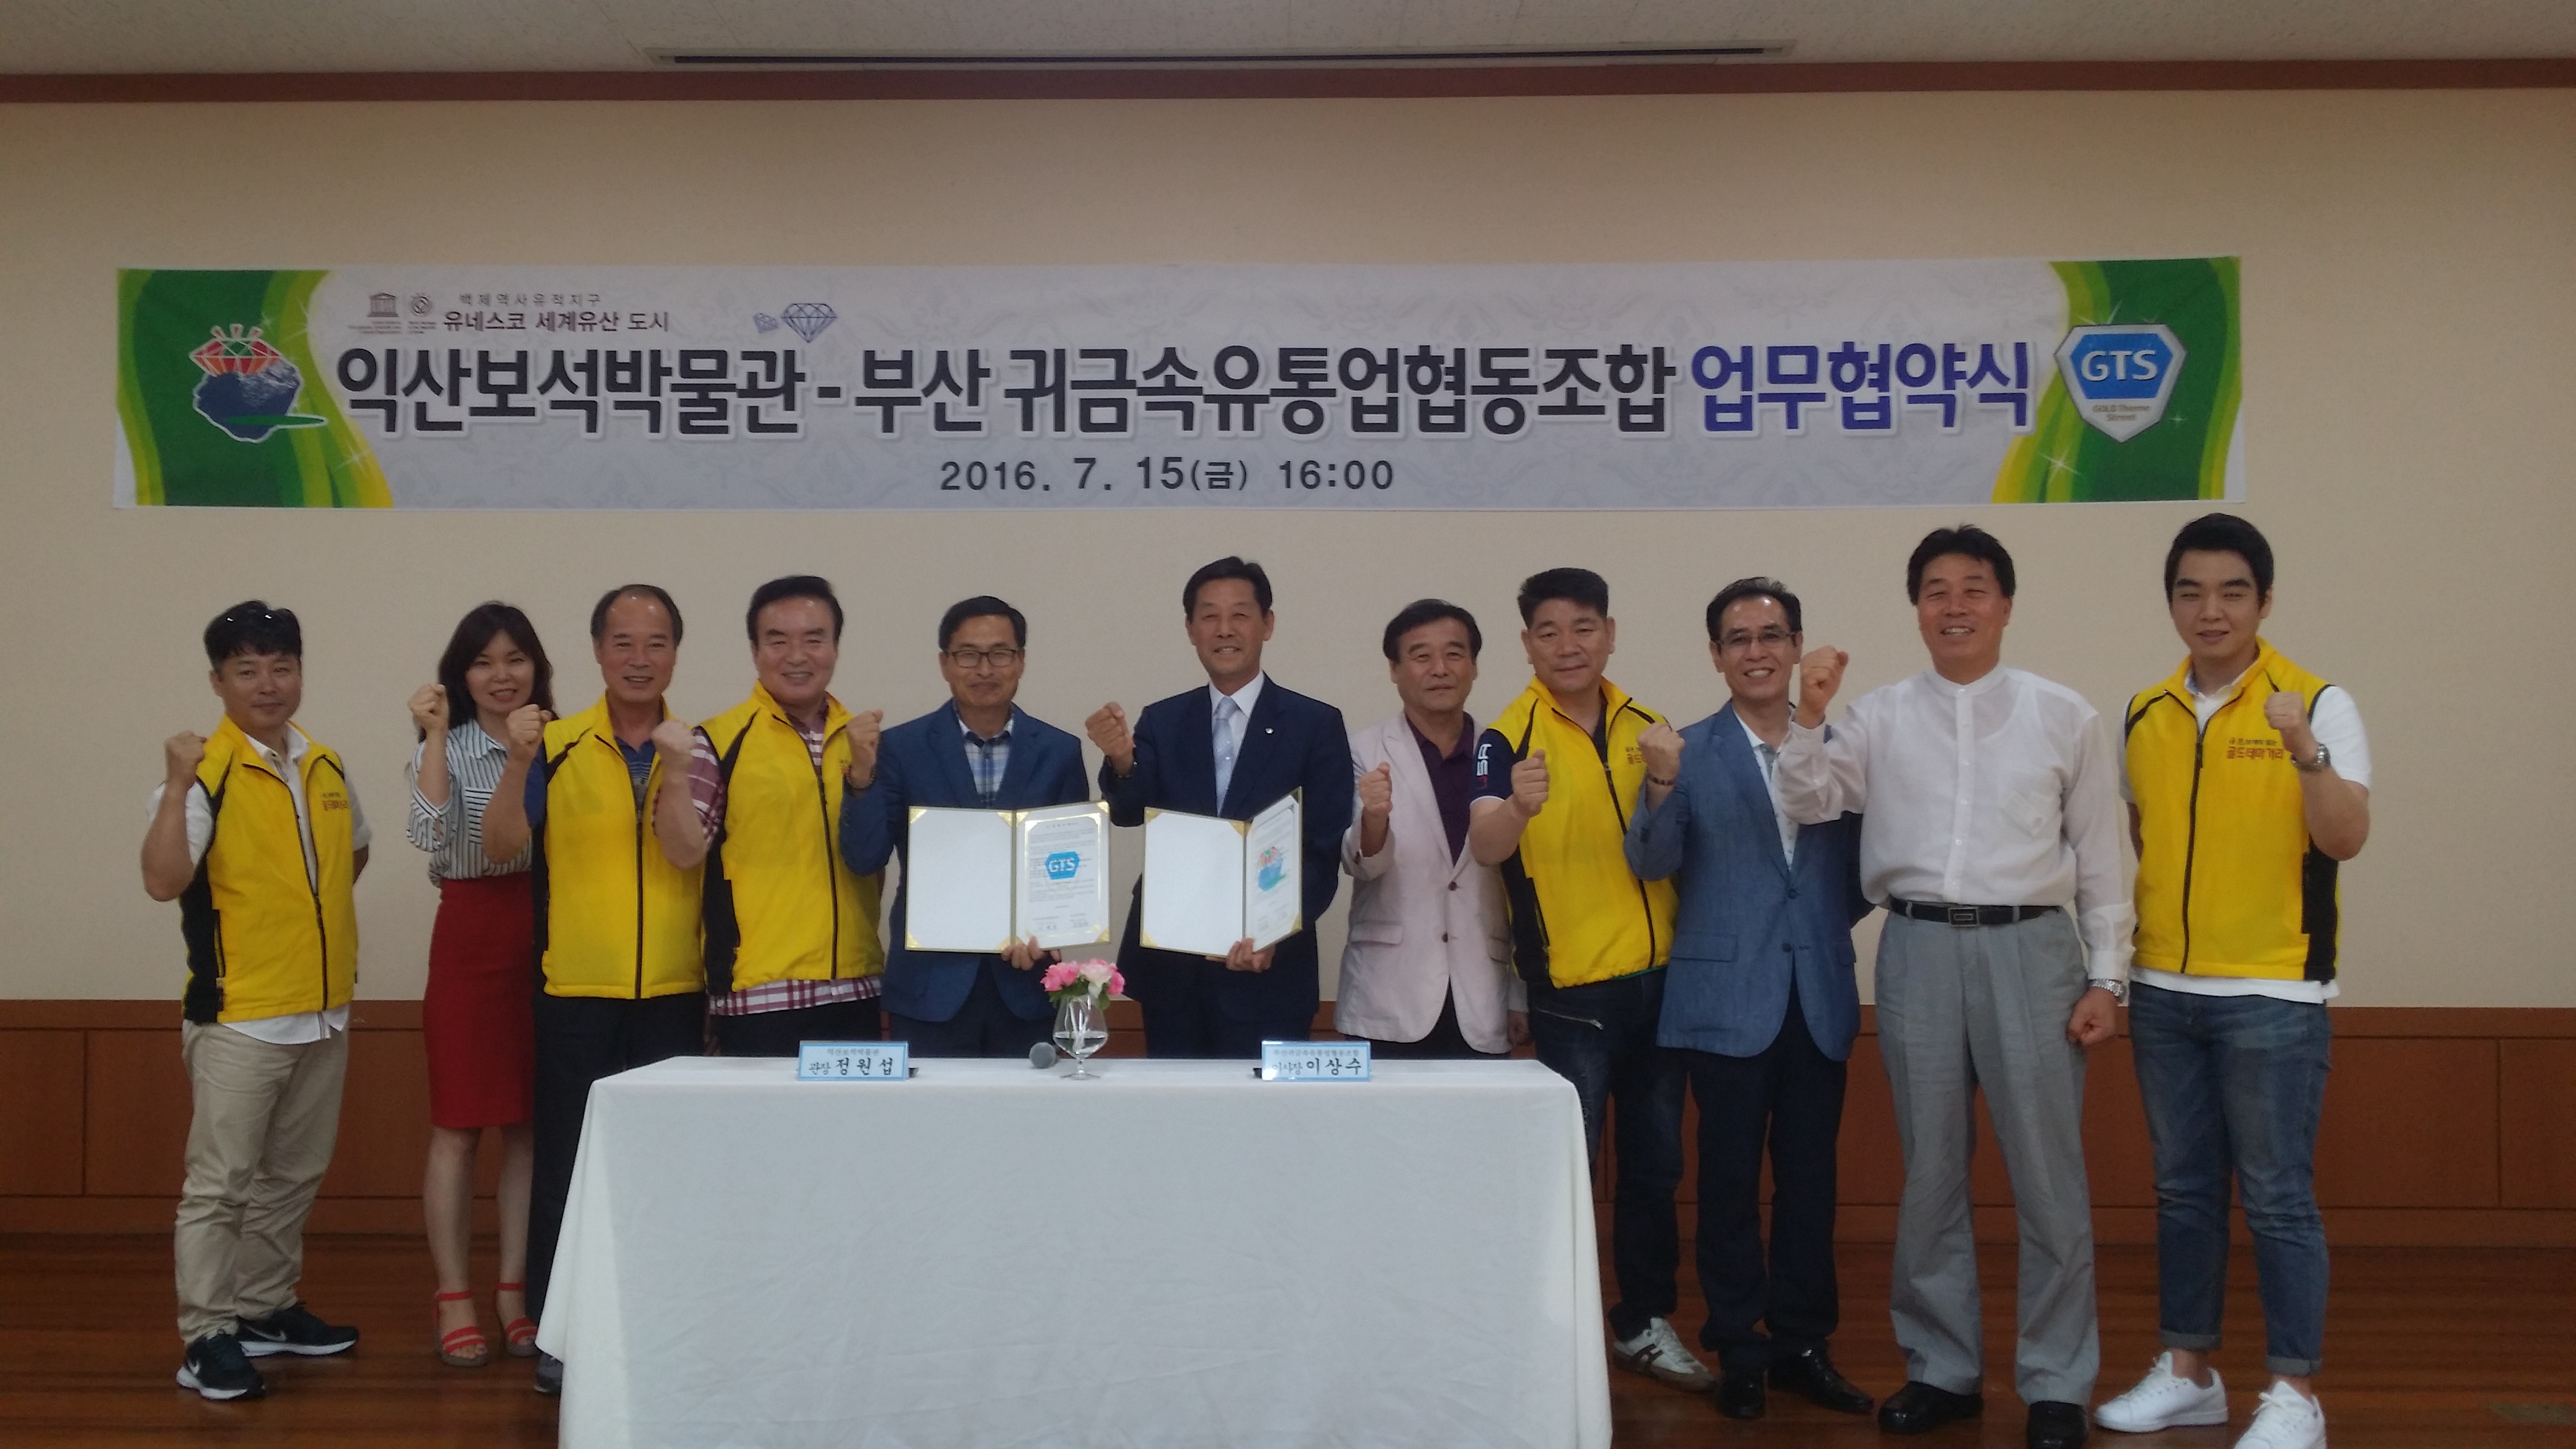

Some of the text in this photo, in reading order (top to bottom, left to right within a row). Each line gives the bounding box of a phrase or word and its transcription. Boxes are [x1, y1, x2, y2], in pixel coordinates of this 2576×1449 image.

[444, 311, 527, 332] 유네스코
[535, 311, 620, 332] 세계유산
[627, 312, 669, 332] 도시
[2081, 349, 2158, 381] GTS
[338, 348, 806, 434] 익산보석박물관
[856, 349, 990, 433] 부산
[1005, 344, 1676, 435] 귀금속유통업협동조합
[1691, 341, 2029, 432] 업무협약식
[941, 456, 1393, 492] 2016. 7. 15(금) 16:00
[1049, 858, 1075, 872] GTS
